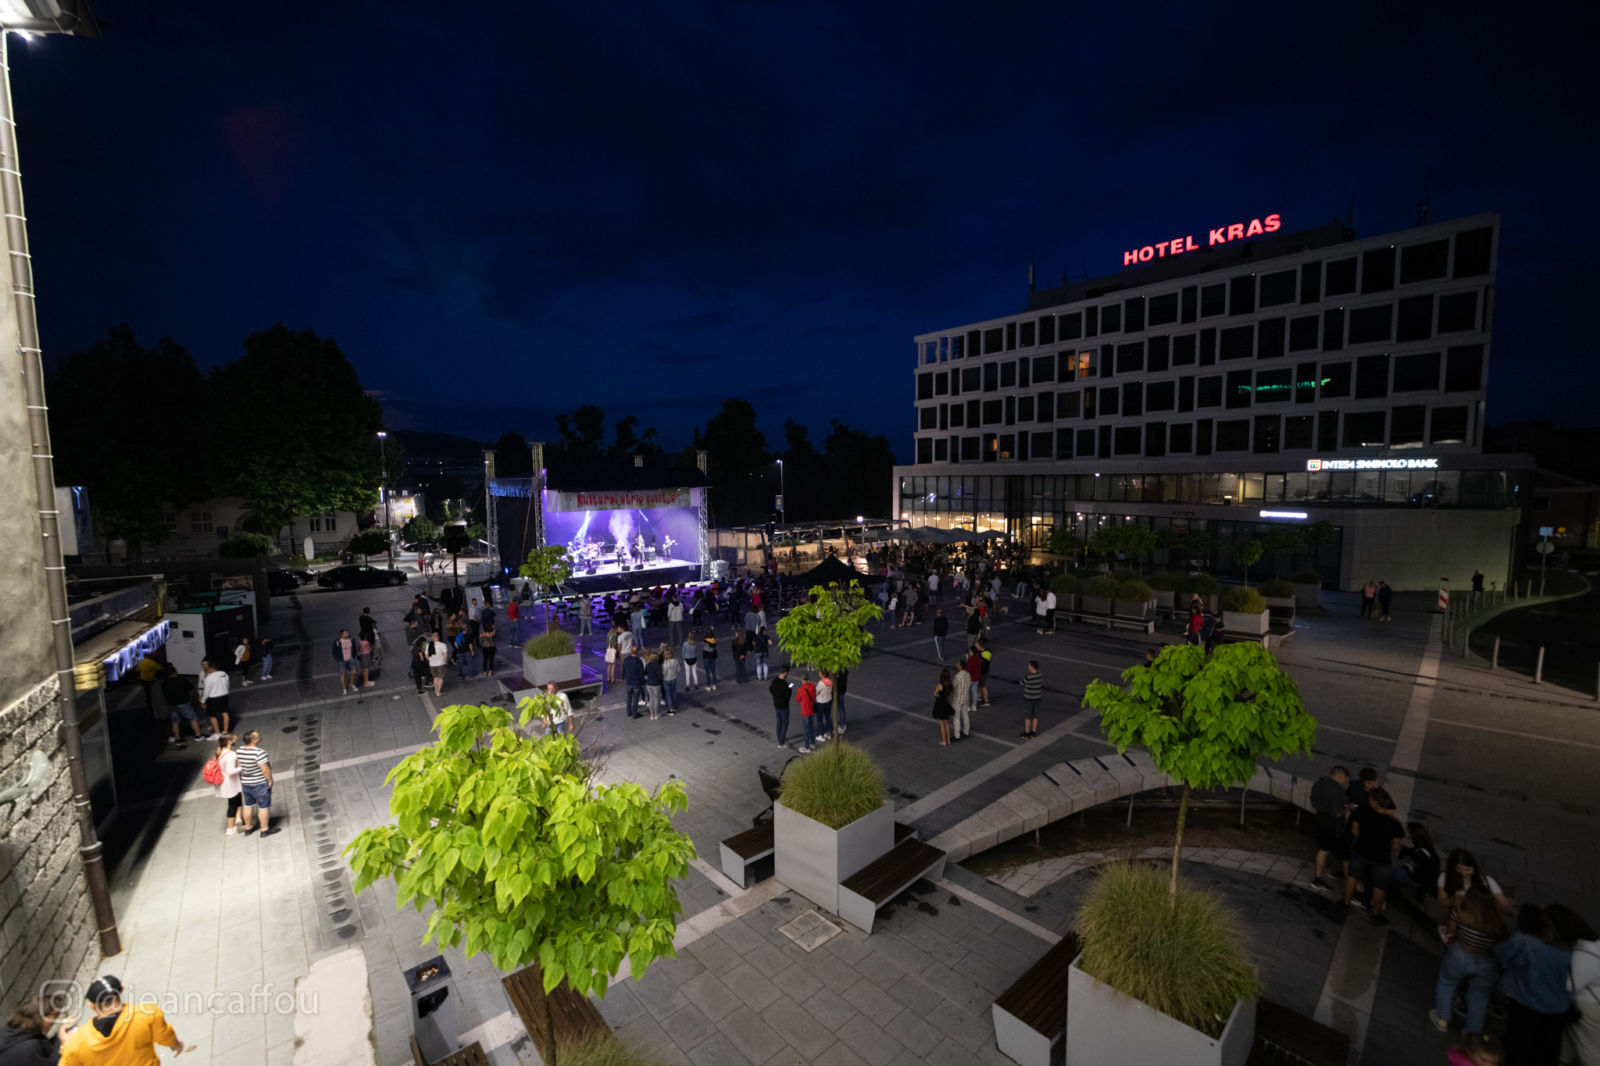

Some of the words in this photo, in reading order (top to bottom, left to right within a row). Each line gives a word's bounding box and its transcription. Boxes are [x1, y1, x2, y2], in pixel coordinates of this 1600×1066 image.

[1123, 235, 1199, 266] HOTEL
[1209, 213, 1282, 246] KRAS
[1322, 460, 1355, 469] INTESA
[1408, 458, 1438, 468] BANK
